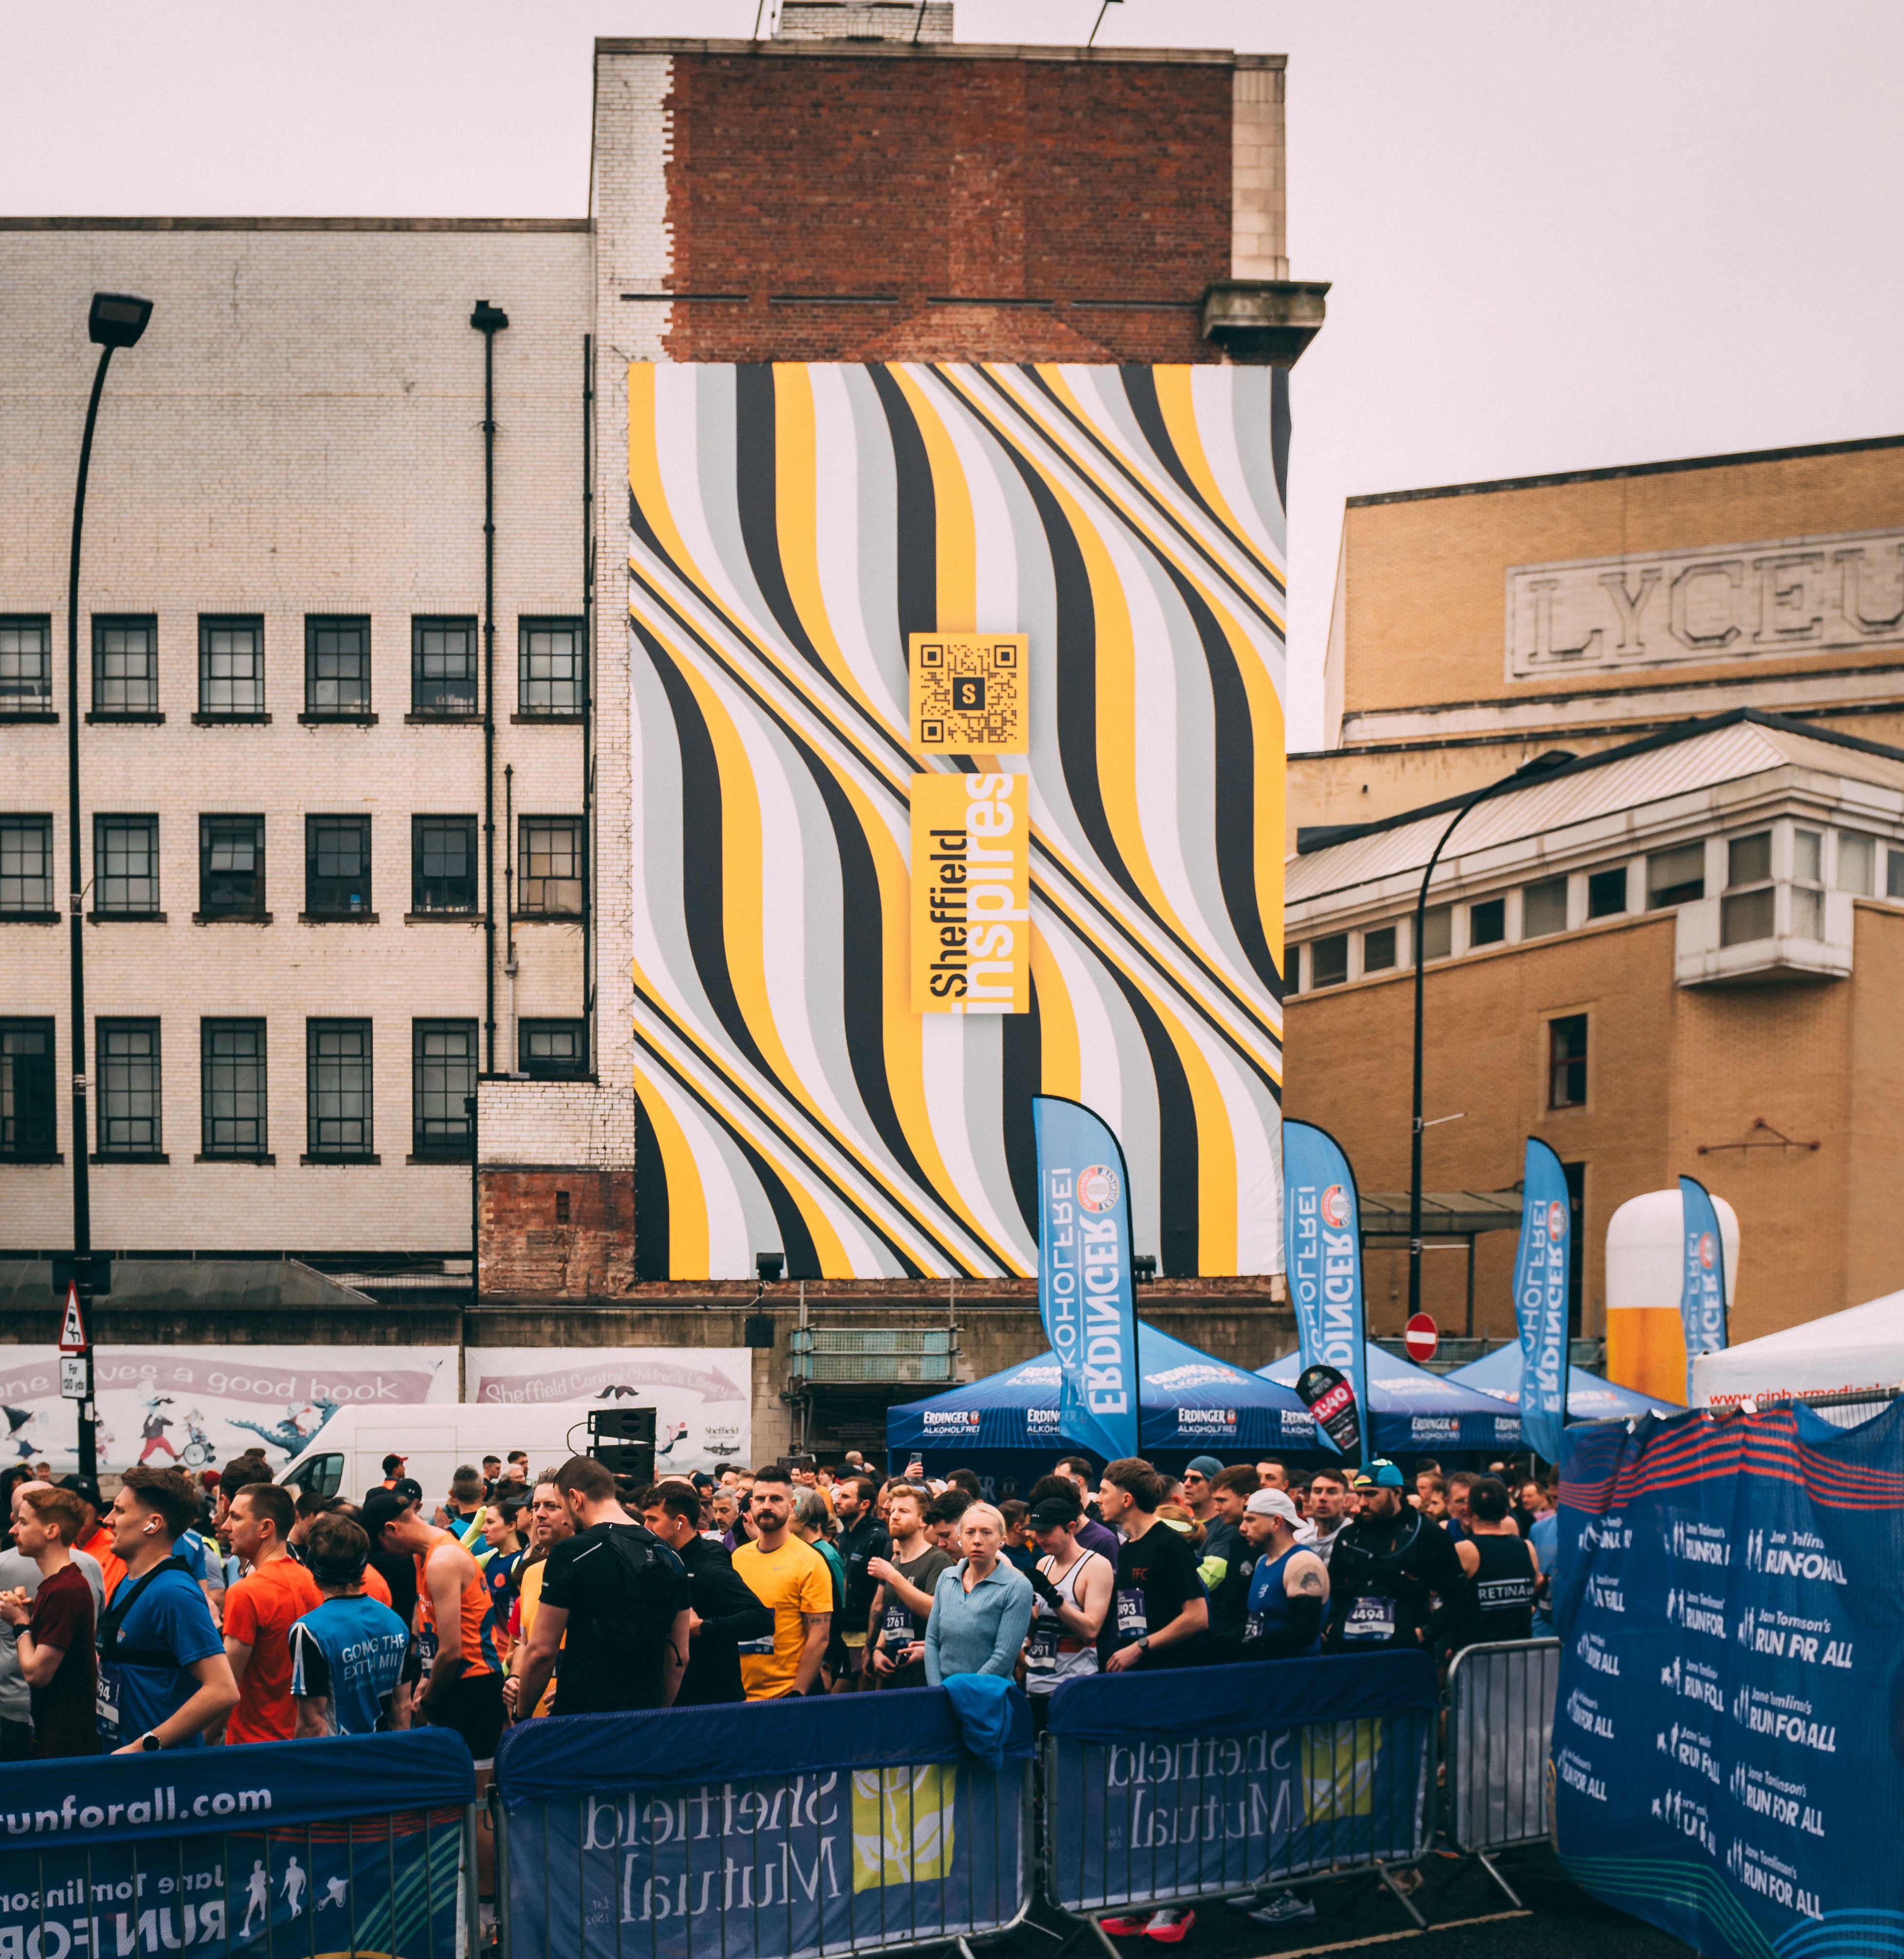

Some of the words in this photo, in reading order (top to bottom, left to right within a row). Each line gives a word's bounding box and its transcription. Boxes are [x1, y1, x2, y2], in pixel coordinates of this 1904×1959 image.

[951, 773, 1029, 1014] inspires
[930, 830, 968, 998] Sheffield
[0, 1376, 49, 1398] ne
[97, 1364, 158, 1382] ves
[172, 1367, 193, 1384] a
[207, 1371, 296, 1398] good
[310, 1376, 400, 1401] book
[486, 1377, 568, 1403] Sheffield
[570, 1368, 624, 1391] Central
[687, 1371, 730, 1398] Library
[923, 1411, 969, 1425] ERDINGER
[1178, 1407, 1226, 1424] ERDINGER
[1314, 1386, 1348, 1419] 1:40
[923, 1425, 980, 1434] ALKOHOLFREI
[1765, 1549, 1798, 1577] RUN
[1478, 1584, 1526, 1600] RETINA
[342, 1638, 379, 1663] GOING
[382, 1633, 405, 1651] THE
[1755, 1628, 1785, 1656] RUN
[1821, 1641, 1853, 1669] ALL
[1750, 1705, 1775, 1736] RUN
[1807, 1723, 1836, 1753] ALL
[1746, 1784, 1772, 1816] RUN
[1772, 1794, 1800, 1827] FOR
[1801, 1806, 1825, 1837] ALL
[1743, 1861, 1767, 1895] RUN
[1769, 1874, 1793, 1908] FOR
[1796, 1888, 1824, 1922] ALL
